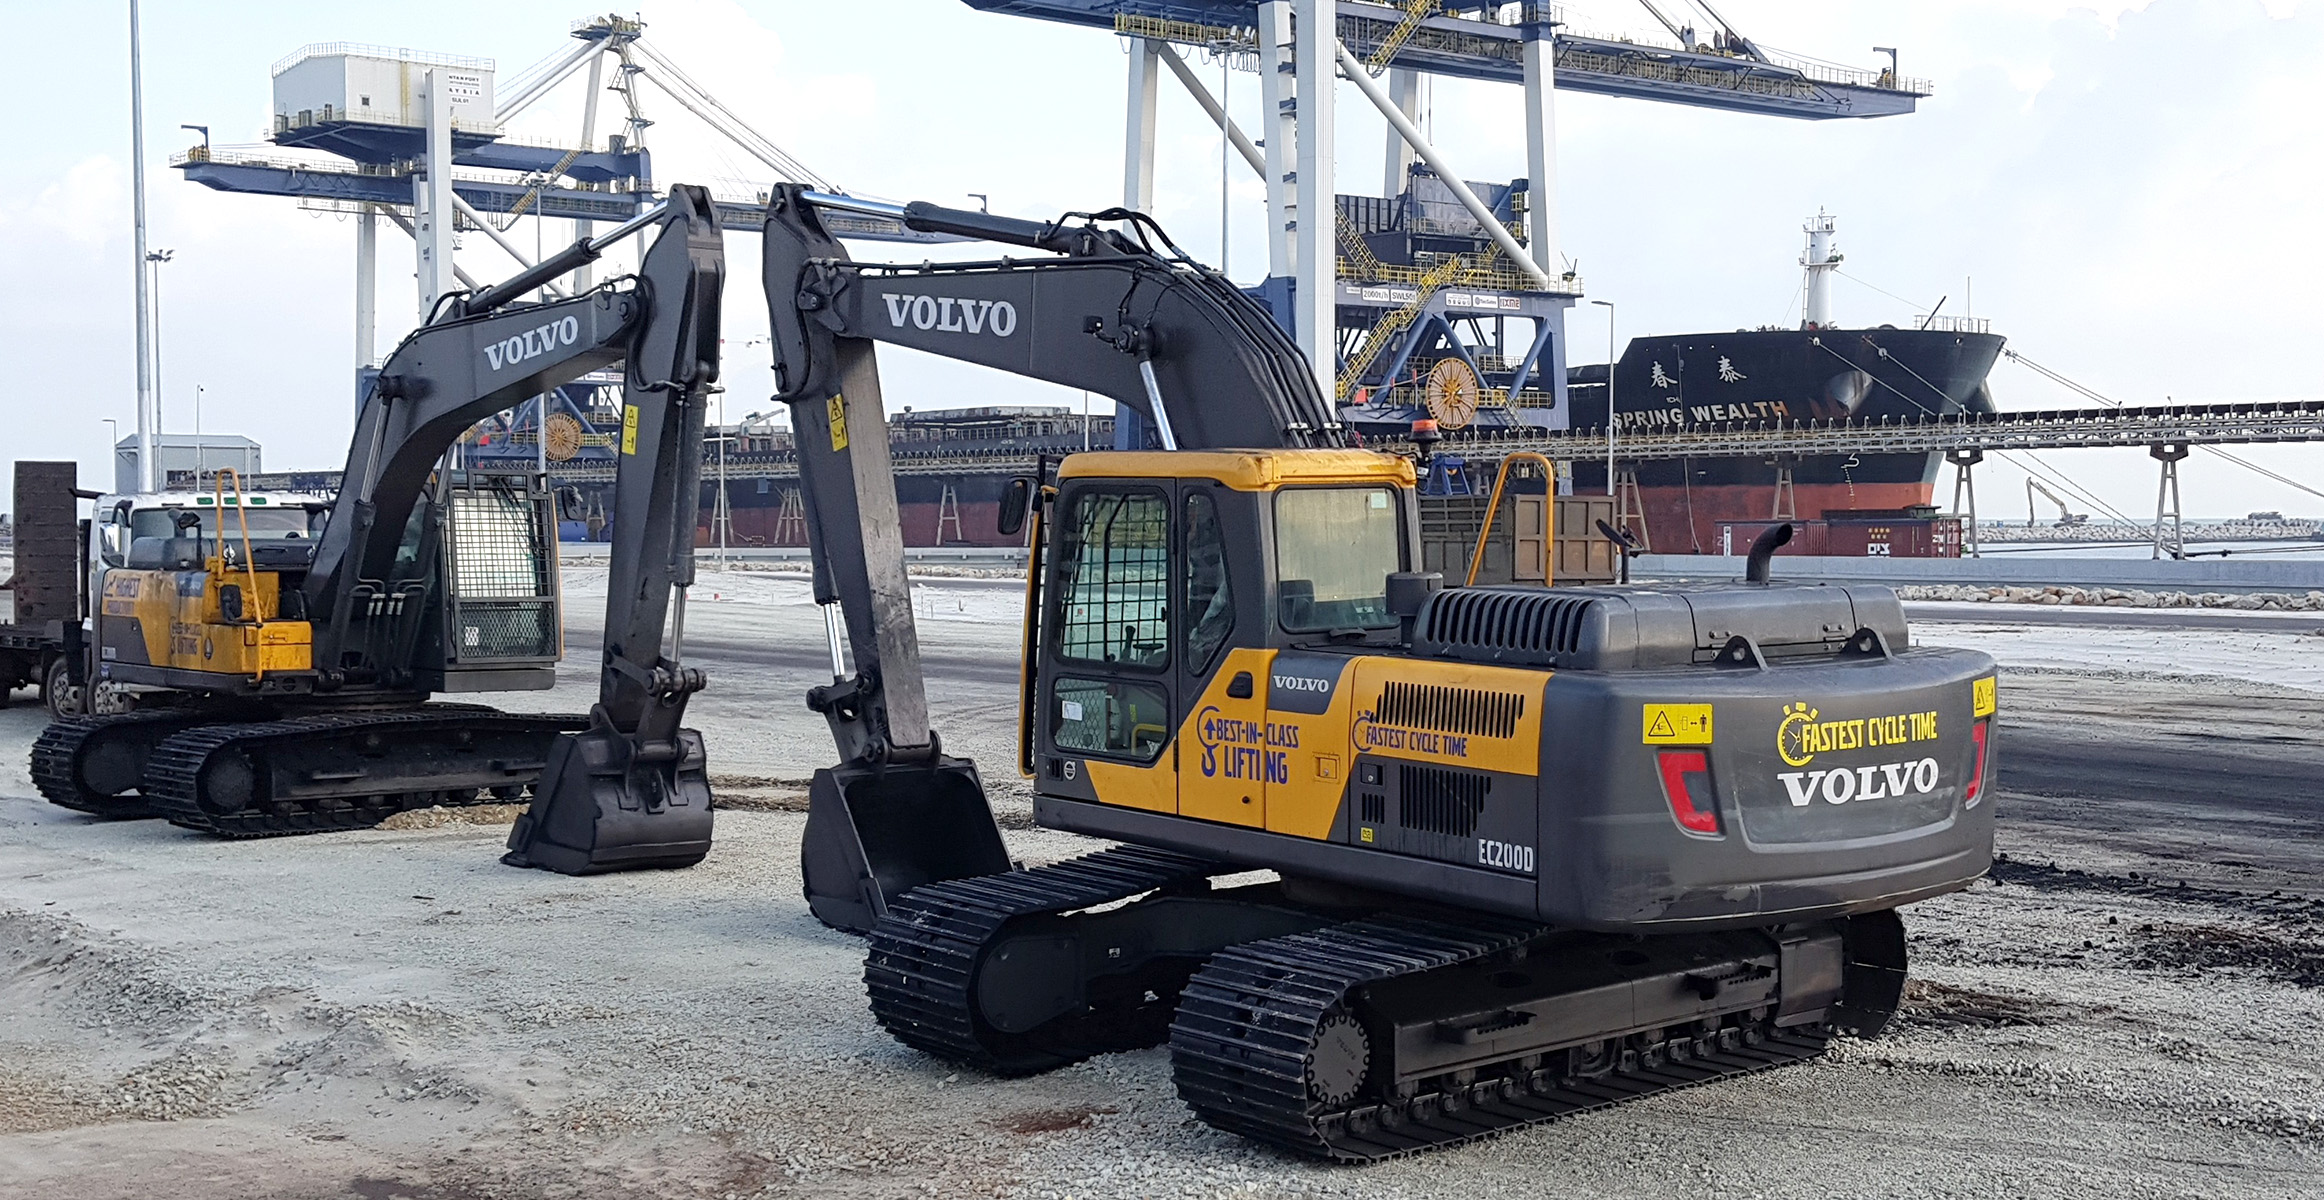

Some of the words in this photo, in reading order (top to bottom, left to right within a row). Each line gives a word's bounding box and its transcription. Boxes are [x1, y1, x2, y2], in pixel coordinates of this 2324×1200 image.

[881, 293, 1017, 337] VOLVO
[484, 315, 578, 371] VOLVO
[1650, 360, 1678, 389] 春
[1717, 355, 1747, 384] 泰
[1613, 407, 1684, 429] SPRING
[1690, 400, 1790, 423] WEALTH
[1273, 675, 1329, 693] VOLVO
[1366, 725, 1407, 749] FASTEST
[1409, 731, 1439, 754] CYCLE
[1442, 735, 1468, 758] TIME
[1802, 718, 1865, 754] FASTEST
[1868, 714, 1907, 747] CYCLE
[1909, 711, 1939, 742] TIME
[1224, 745, 1288, 785] LIFTING
[1777, 757, 1939, 807] VOLVO
[1478, 838, 1534, 873] EC200D
